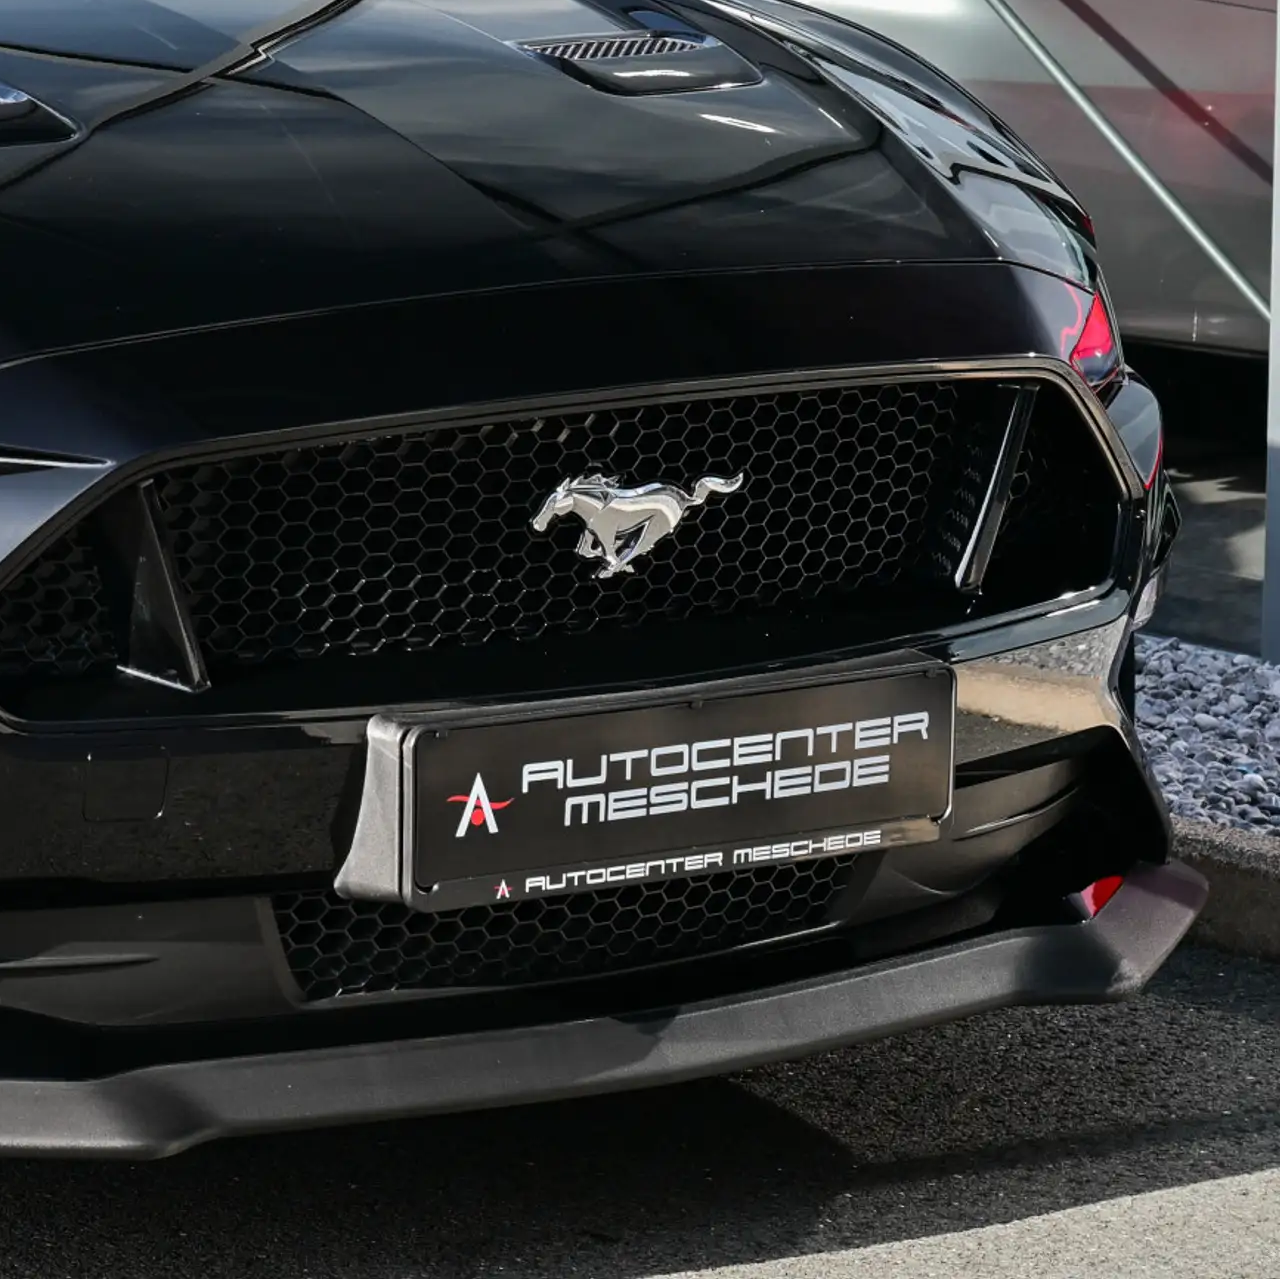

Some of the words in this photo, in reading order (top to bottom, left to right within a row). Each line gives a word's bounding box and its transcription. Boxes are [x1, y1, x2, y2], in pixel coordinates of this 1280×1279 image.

[522, 711, 929, 794] AUTOCENTER
[564, 754, 890, 827] MESCHEDE
[525, 851, 723, 893] AUTOCENTER
[733, 830, 881, 864] MESCHEDE
